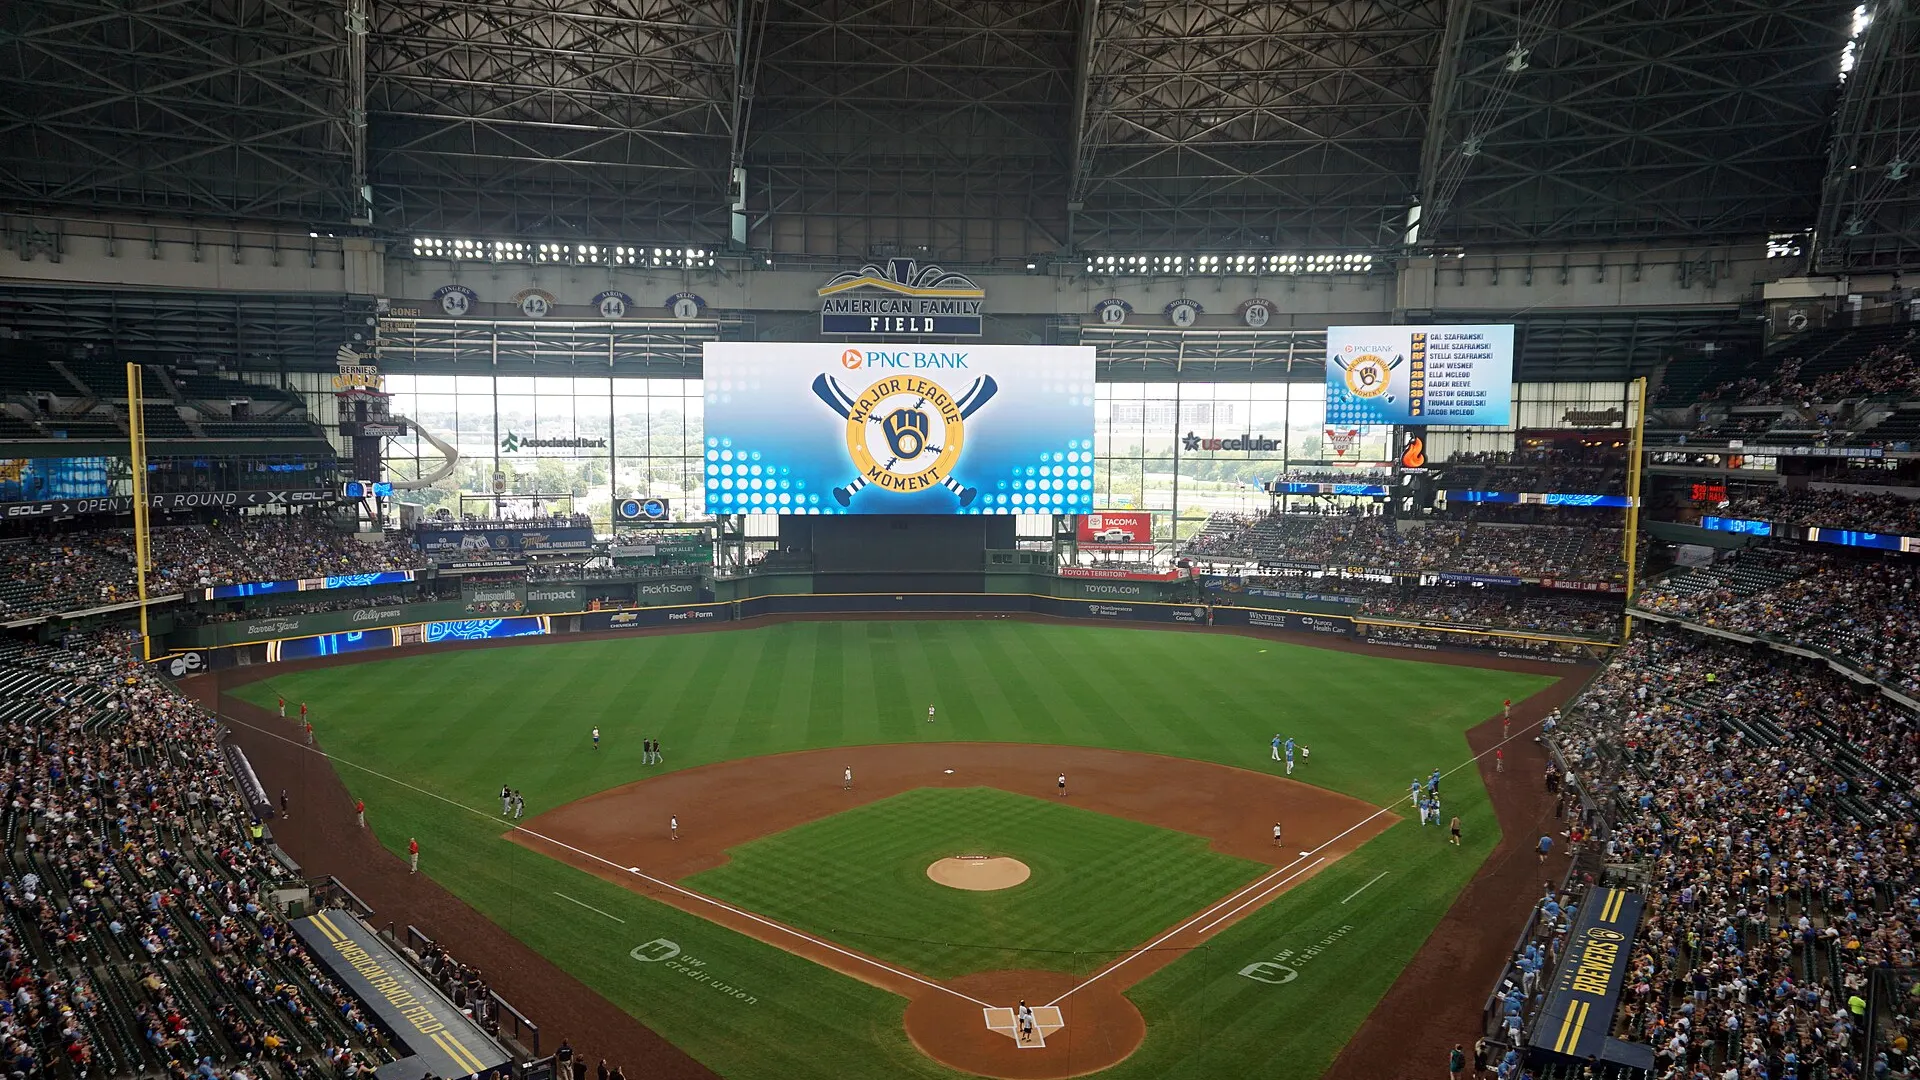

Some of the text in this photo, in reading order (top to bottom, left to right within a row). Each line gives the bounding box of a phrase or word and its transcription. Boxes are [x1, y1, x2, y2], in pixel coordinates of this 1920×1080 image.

[440, 286, 470, 294] FINGERS
[446, 297, 465, 310] 34
[526, 300, 544, 312] 42
[603, 302, 622, 313] 44
[824, 300, 982, 314] AMERICAN FAMILY
[1170, 300, 1198, 308] MOLITOR
[391, 308, 420, 316] GONE!
[682, 304, 688, 315] 1
[1250, 308, 1264, 318] 50
[1105, 310, 1121, 321] 19
[1179, 310, 1187, 322] 4
[870, 316, 934, 332] FIELD
[866, 352, 969, 369] PNC BANK
[1412, 352, 1425, 360] RF
[341, 366, 376, 374] BERNIE'S
[332, 374, 385, 388] CHALET
[1411, 380, 1424, 388] SS
[1410, 390, 1424, 398] 3B
[852, 379, 959, 425] MAJOR LEAGUE
[520, 438, 608, 448] Associated Bank
[1202, 434, 1281, 450] uscellular
[868, 466, 940, 490] MOMENT
[8, 504, 52, 516] GOLF
[78, 499, 116, 512] OPEN
[124, 495, 164, 510] YR
[174, 493, 236, 506] ROUND
[292, 492, 333, 500] GOLF
[1104, 518, 1138, 526] TACOMA
[1064, 568, 1126, 578] TOYOTA TERRITORY
[642, 585, 660, 594] Pick
[670, 584, 692, 593] Save
[1085, 584, 1140, 594] TOYOTA.COM
[1554, 580, 1581, 588] NICOLET
[537, 590, 576, 600] impact
[353, 610, 400, 622] Bally SPORTS
[669, 612, 687, 620] Fleet
[1250, 612, 1286, 622] WINTRUST
[1332, 626, 1346, 634] Care
[1290, 924, 1355, 967] credit union
[680, 955, 706, 967] uw
[1273, 949, 1294, 962] uw
[1572, 940, 1619, 996] BREWERS
[332, 940, 444, 1034] AMERICAN FAMILY FIELD
[665, 961, 758, 1005] credit union
